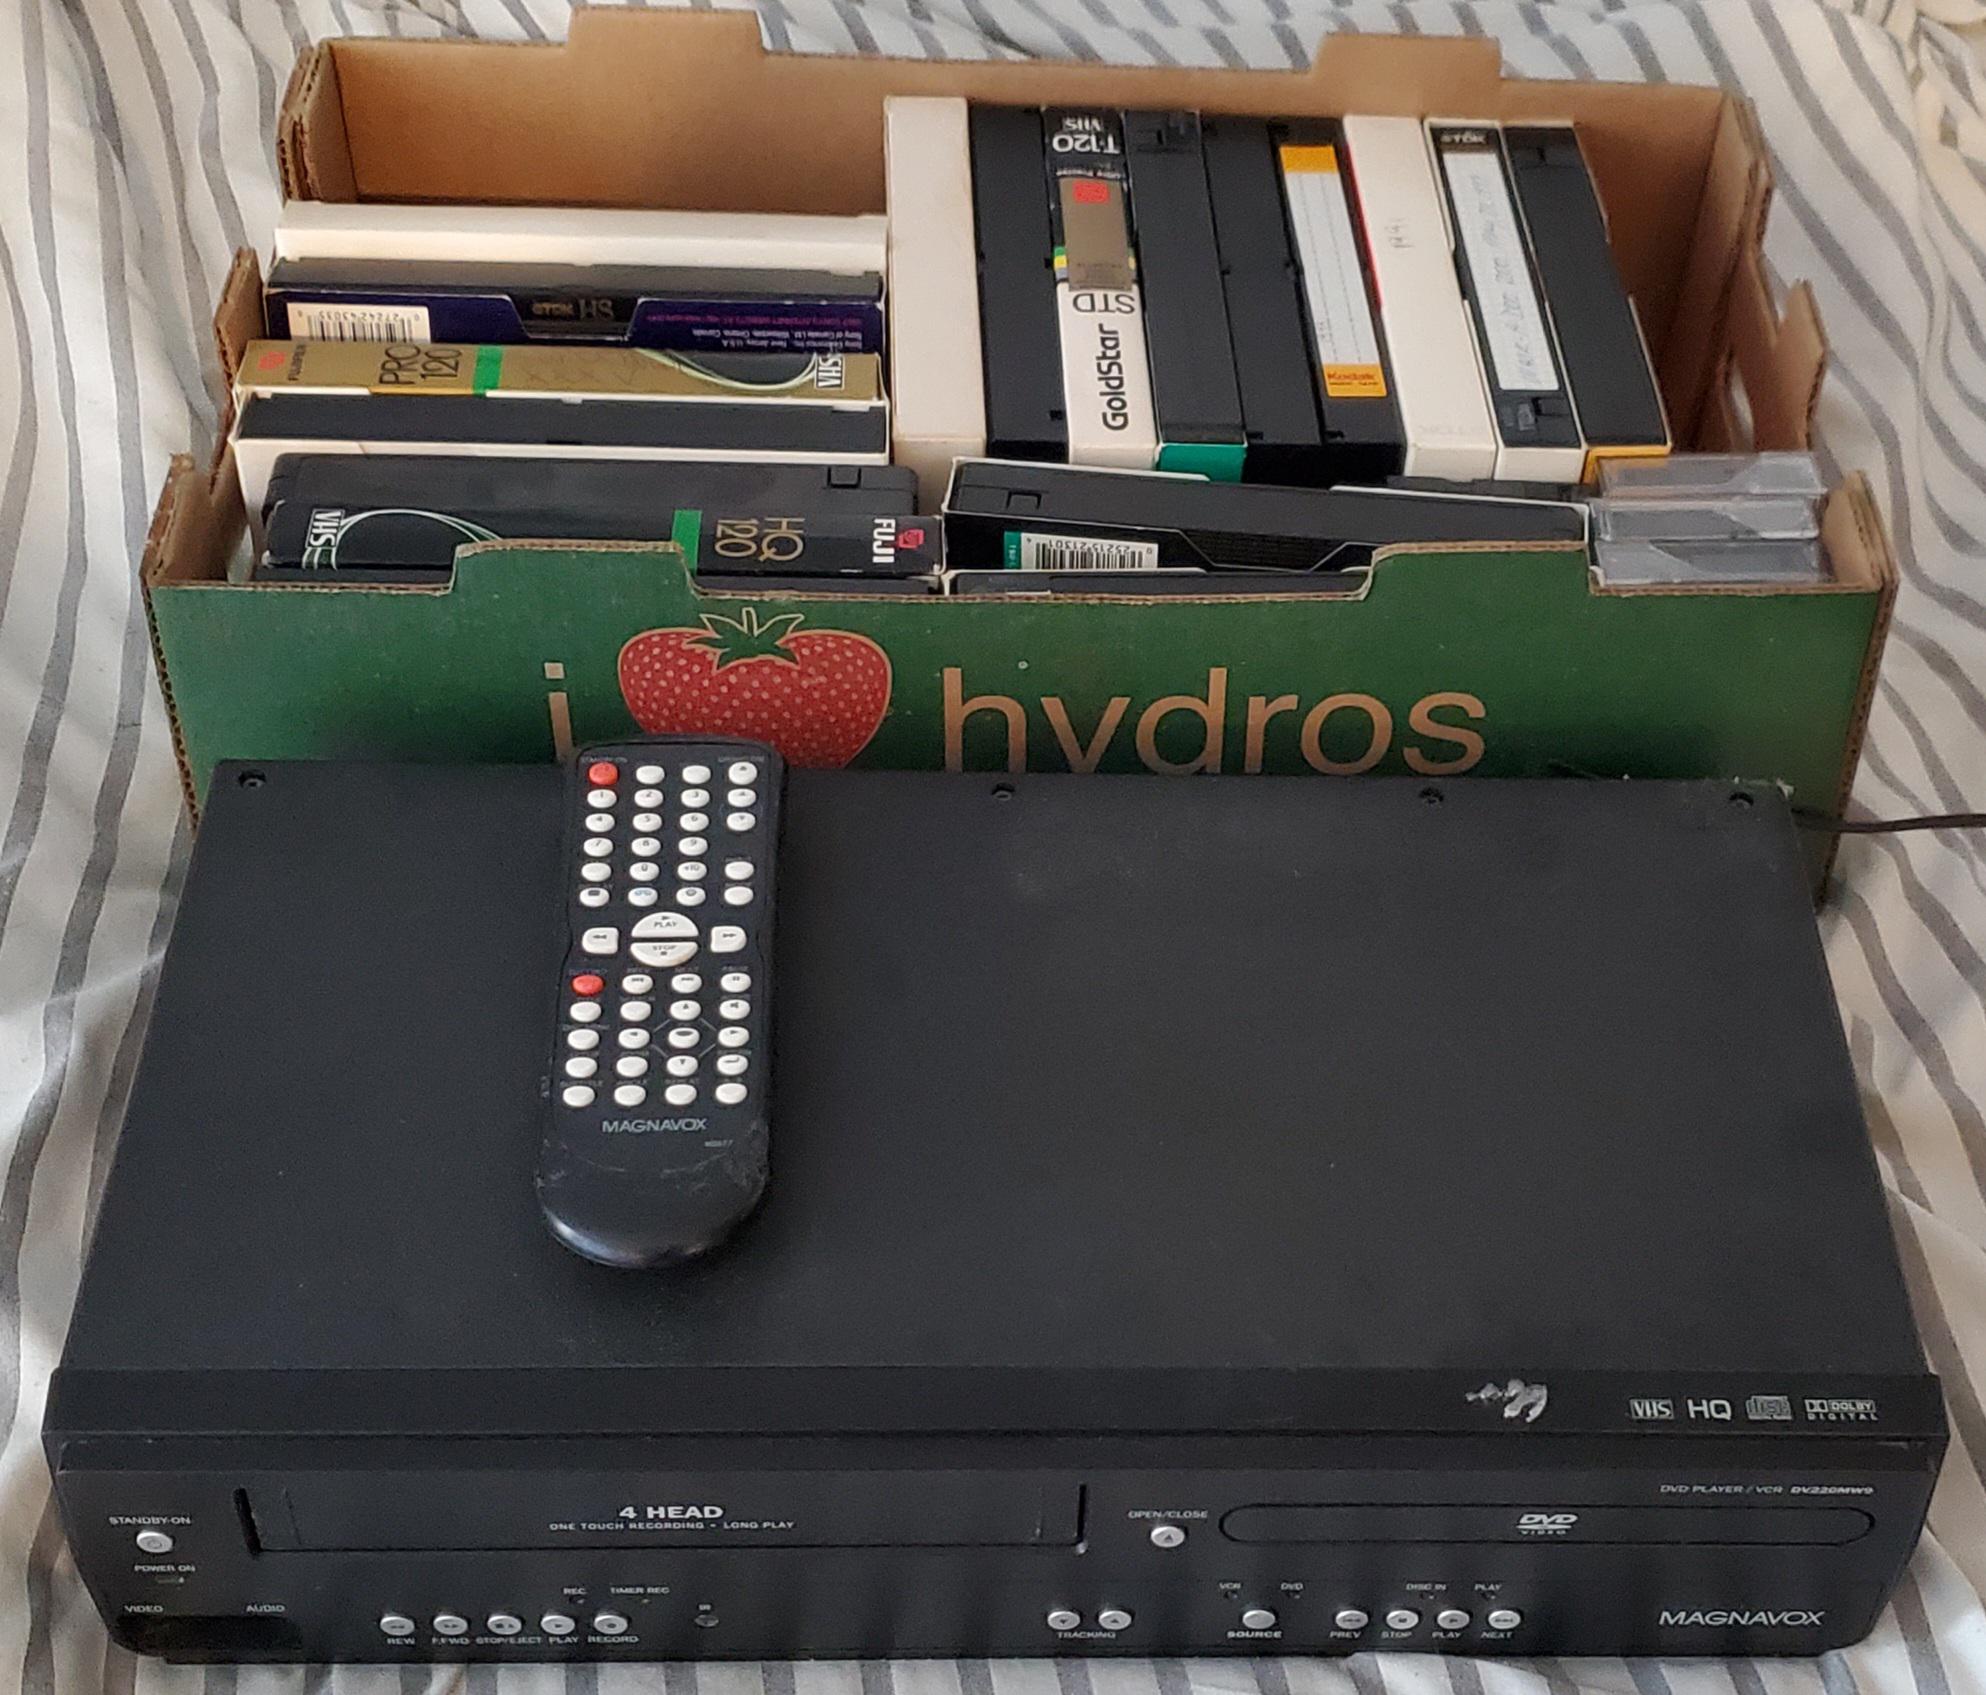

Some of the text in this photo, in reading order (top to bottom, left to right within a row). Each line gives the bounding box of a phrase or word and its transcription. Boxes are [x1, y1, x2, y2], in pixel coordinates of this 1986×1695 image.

[1073, 293, 1135, 314] STD
[379, 344, 462, 385] PRO 120
[816, 353, 843, 389] VHS
[1096, 323, 1129, 431] GoldStar
[308, 509, 343, 548] VHS
[715, 517, 805, 561] HQ 120
[872, 519, 896, 563] FUJI
[602, 1118, 708, 1133] MAGNAVOX
[1631, 1399, 1673, 1419] VHS
[1687, 1399, 1732, 1421] HQ
[1660, 1484, 1689, 1494] DVD
[1692, 1484, 1743, 1494] PLAYER
[1756, 1484, 1783, 1494] VCR
[619, 1506, 724, 1519] 4 HEAD
[1128, 1510, 1208, 1519] OPEN/CLOSE
[1518, 1513, 1578, 1525] DVD
[549, 1521, 795, 1531] ONE TOUCH RECORDING LONG PLAY
[134, 1564, 196, 1573] POWER ON
[563, 1587, 587, 1596] REC
[610, 1586, 670, 1595] TIMER REC
[1281, 1582, 1304, 1591] DVD
[1406, 1583, 1432, 1591] DISC
[1474, 1583, 1502, 1591] PLAY
[124, 1604, 164, 1614] VIDEO
[245, 1604, 286, 1613] AUDIO
[1659, 1610, 1825, 1626] MAGNAVOX
[587, 1634, 639, 1644] RECORD
[1057, 1630, 1117, 1640] TRACKING
[1227, 1629, 1283, 1639] SOURCE
[1329, 1630, 1362, 1639] PREV
[1381, 1630, 1412, 1639] STOP
[1431, 1630, 1462, 1639] PLAY
[1480, 1630, 1513, 1639] NEXT
[387, 1636, 415, 1645] REW
[548, 1635, 579, 1645] PLAY
